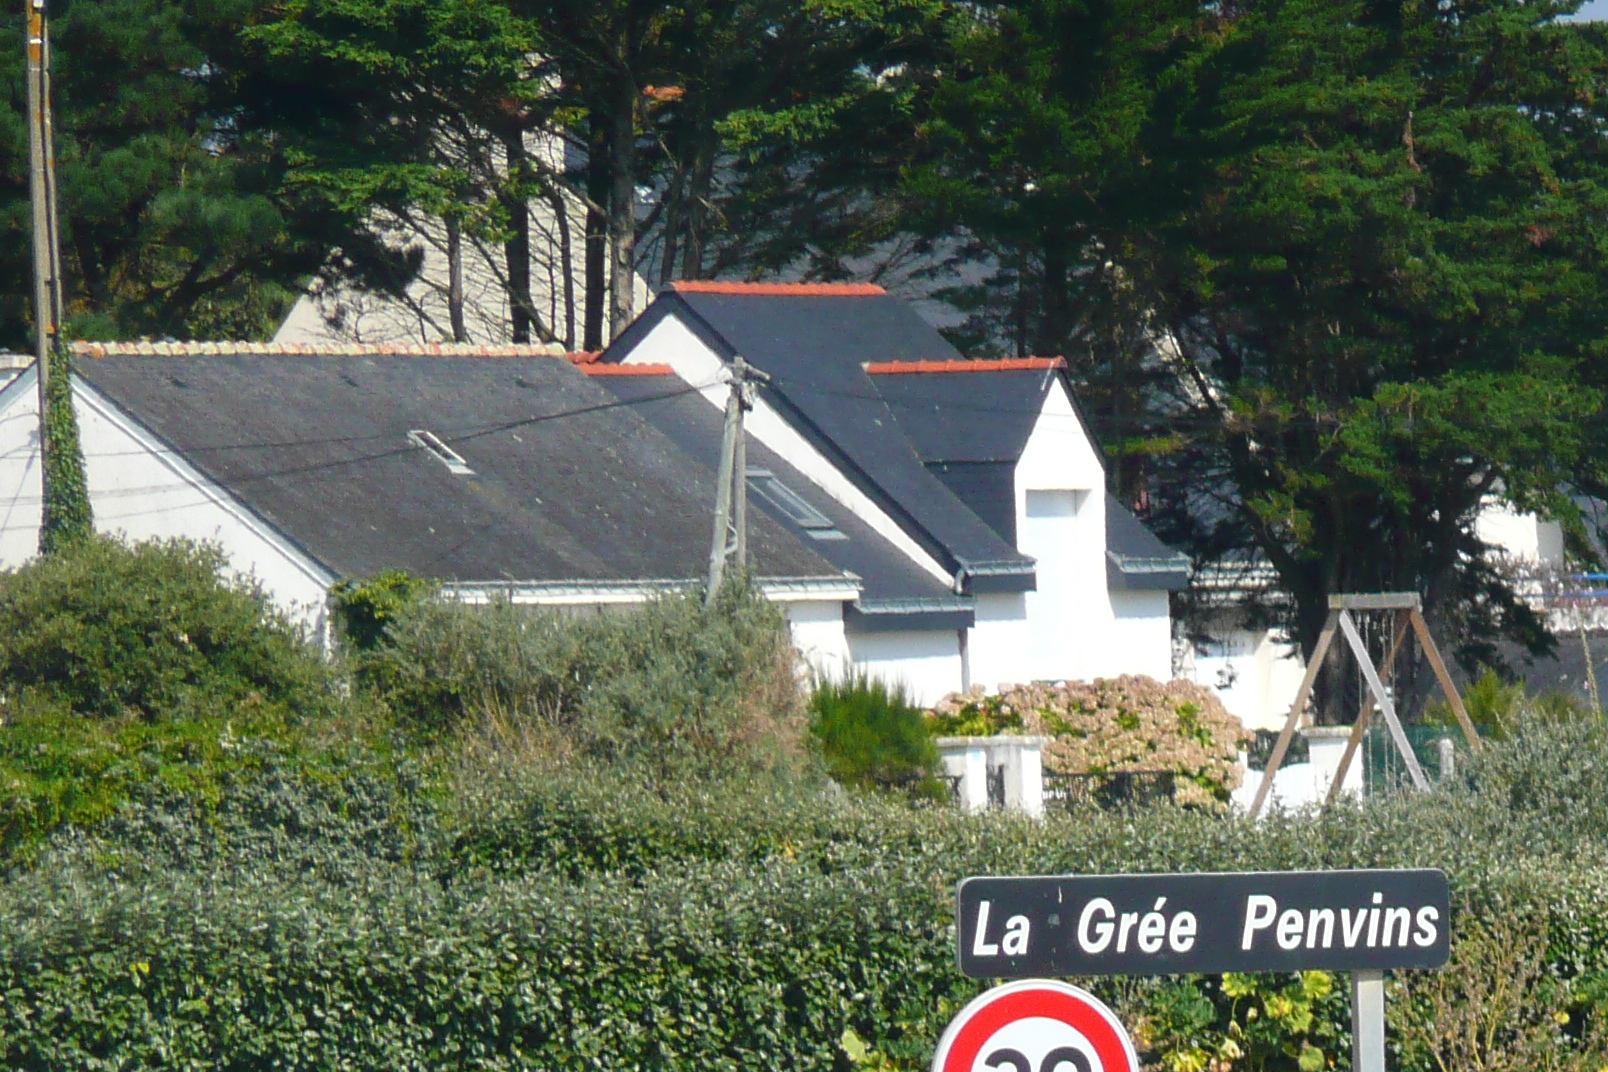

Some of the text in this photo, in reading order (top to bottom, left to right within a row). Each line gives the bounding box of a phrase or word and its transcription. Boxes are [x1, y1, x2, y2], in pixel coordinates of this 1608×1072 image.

[972, 892, 1439, 956] La Grée Penvins
